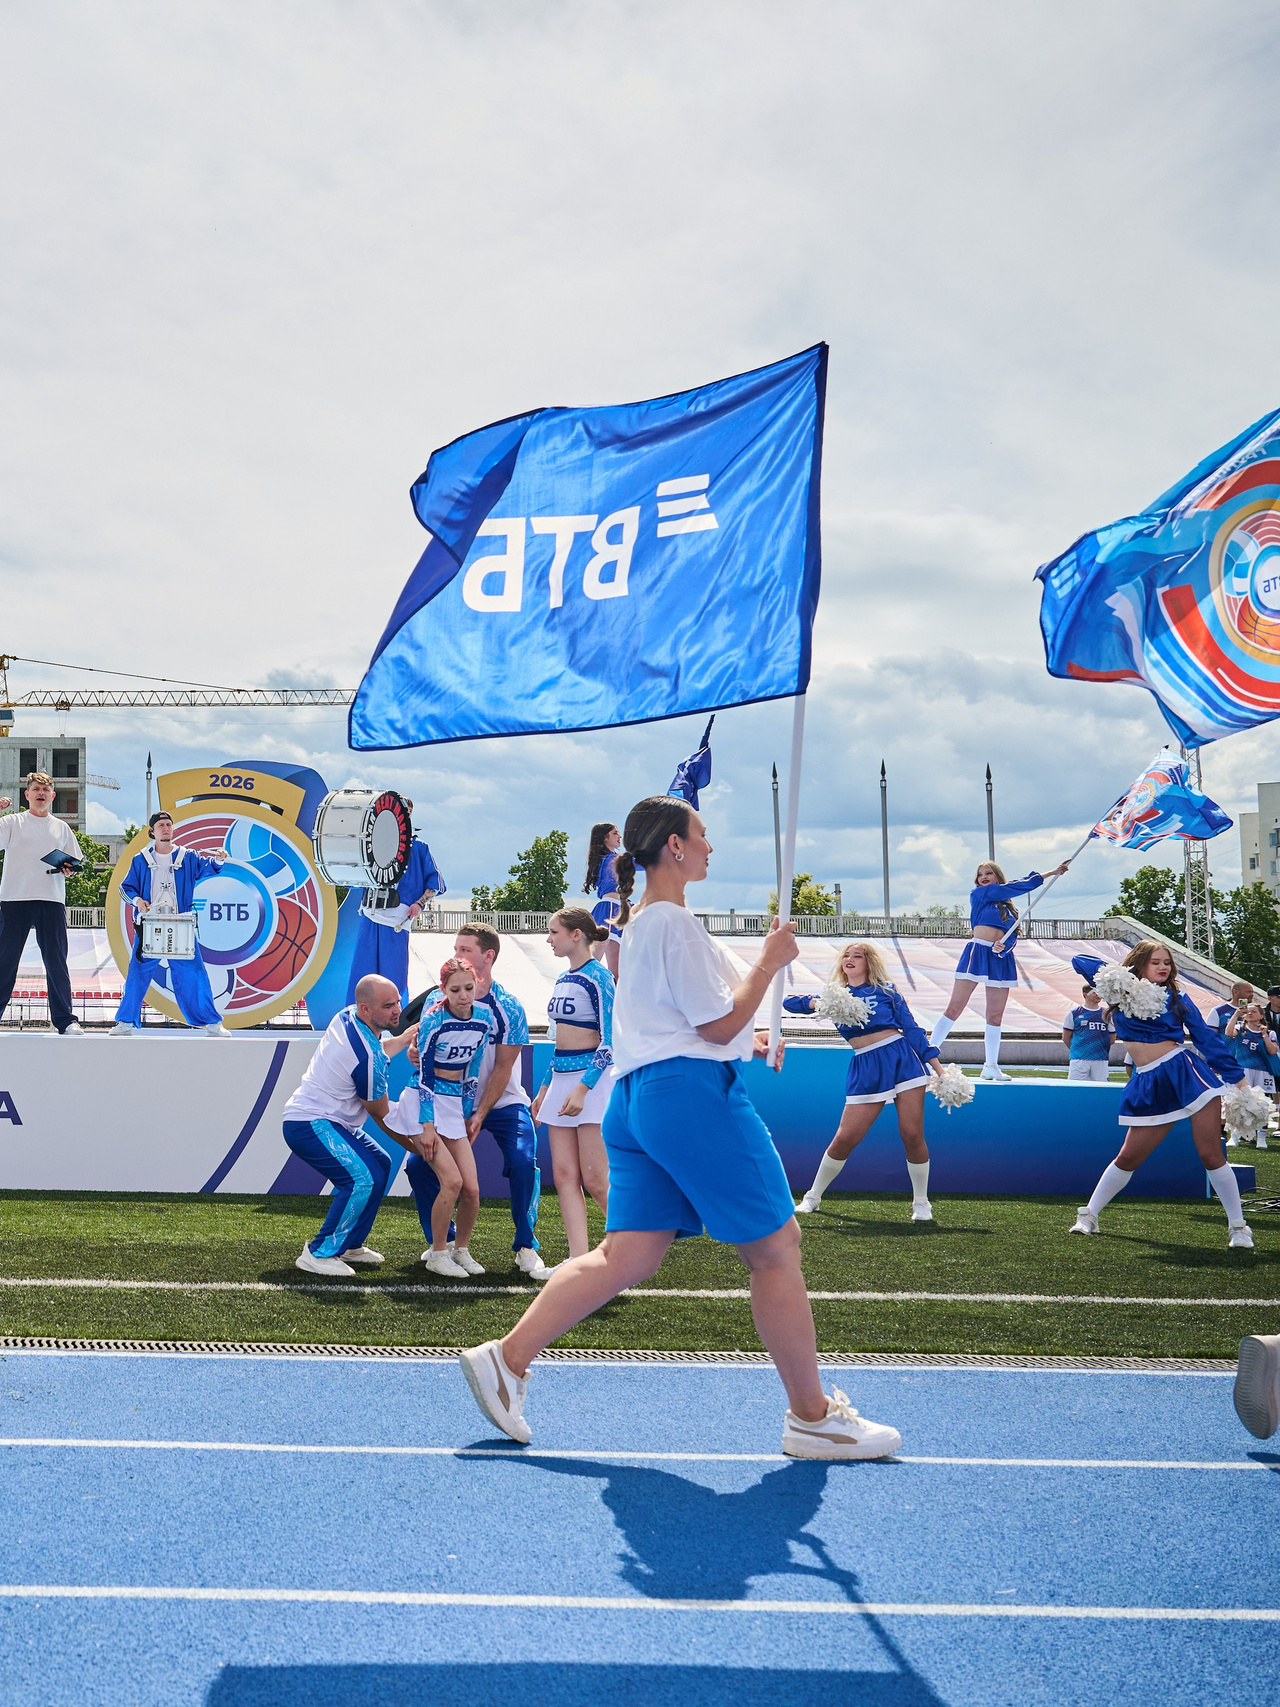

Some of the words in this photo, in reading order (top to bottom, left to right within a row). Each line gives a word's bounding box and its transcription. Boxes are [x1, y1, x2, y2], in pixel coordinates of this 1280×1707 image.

[209, 774, 255, 790] 2026
[375, 795, 395, 815] BEAT
[209, 903, 250, 922] ВТБ
[547, 997, 576, 1015] ВТБ
[1089, 1021, 1107, 1031] ВТБ
